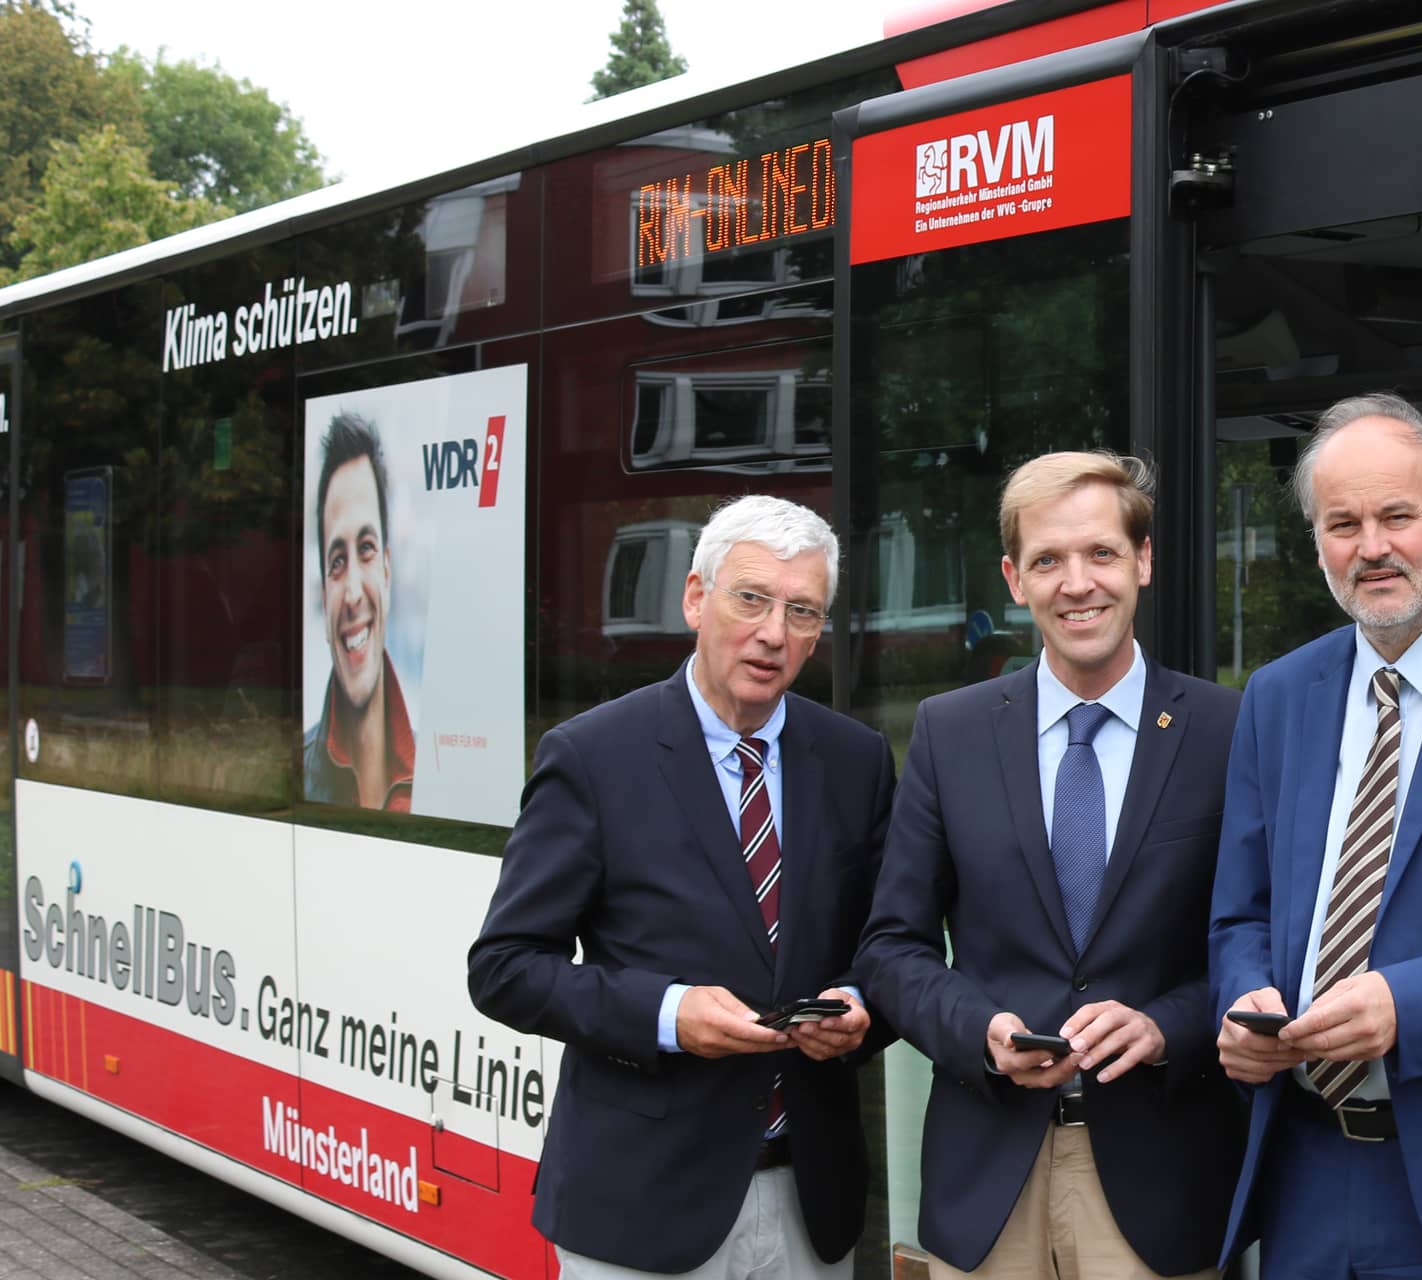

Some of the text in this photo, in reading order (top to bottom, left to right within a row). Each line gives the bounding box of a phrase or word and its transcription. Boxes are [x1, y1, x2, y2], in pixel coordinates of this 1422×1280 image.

[915, 174, 1053, 215] Regionalverkehr Münsterland GmbH
[949, 114, 1054, 193] RVM
[639, 138, 836, 267] RVM-ONLINED
[915, 219, 928, 233] Ein
[928, 211, 980, 231] Unternehmen
[981, 207, 995, 220] der
[997, 202, 1016, 217] WVG
[163, 276, 358, 373] Klima schützen.
[422, 433, 499, 491] WDR 2
[258, 975, 330, 1059] Ganz
[340, 1010, 440, 1094] meine
[453, 1029, 544, 1128] Linie
[262, 1095, 419, 1213] Münsterland
